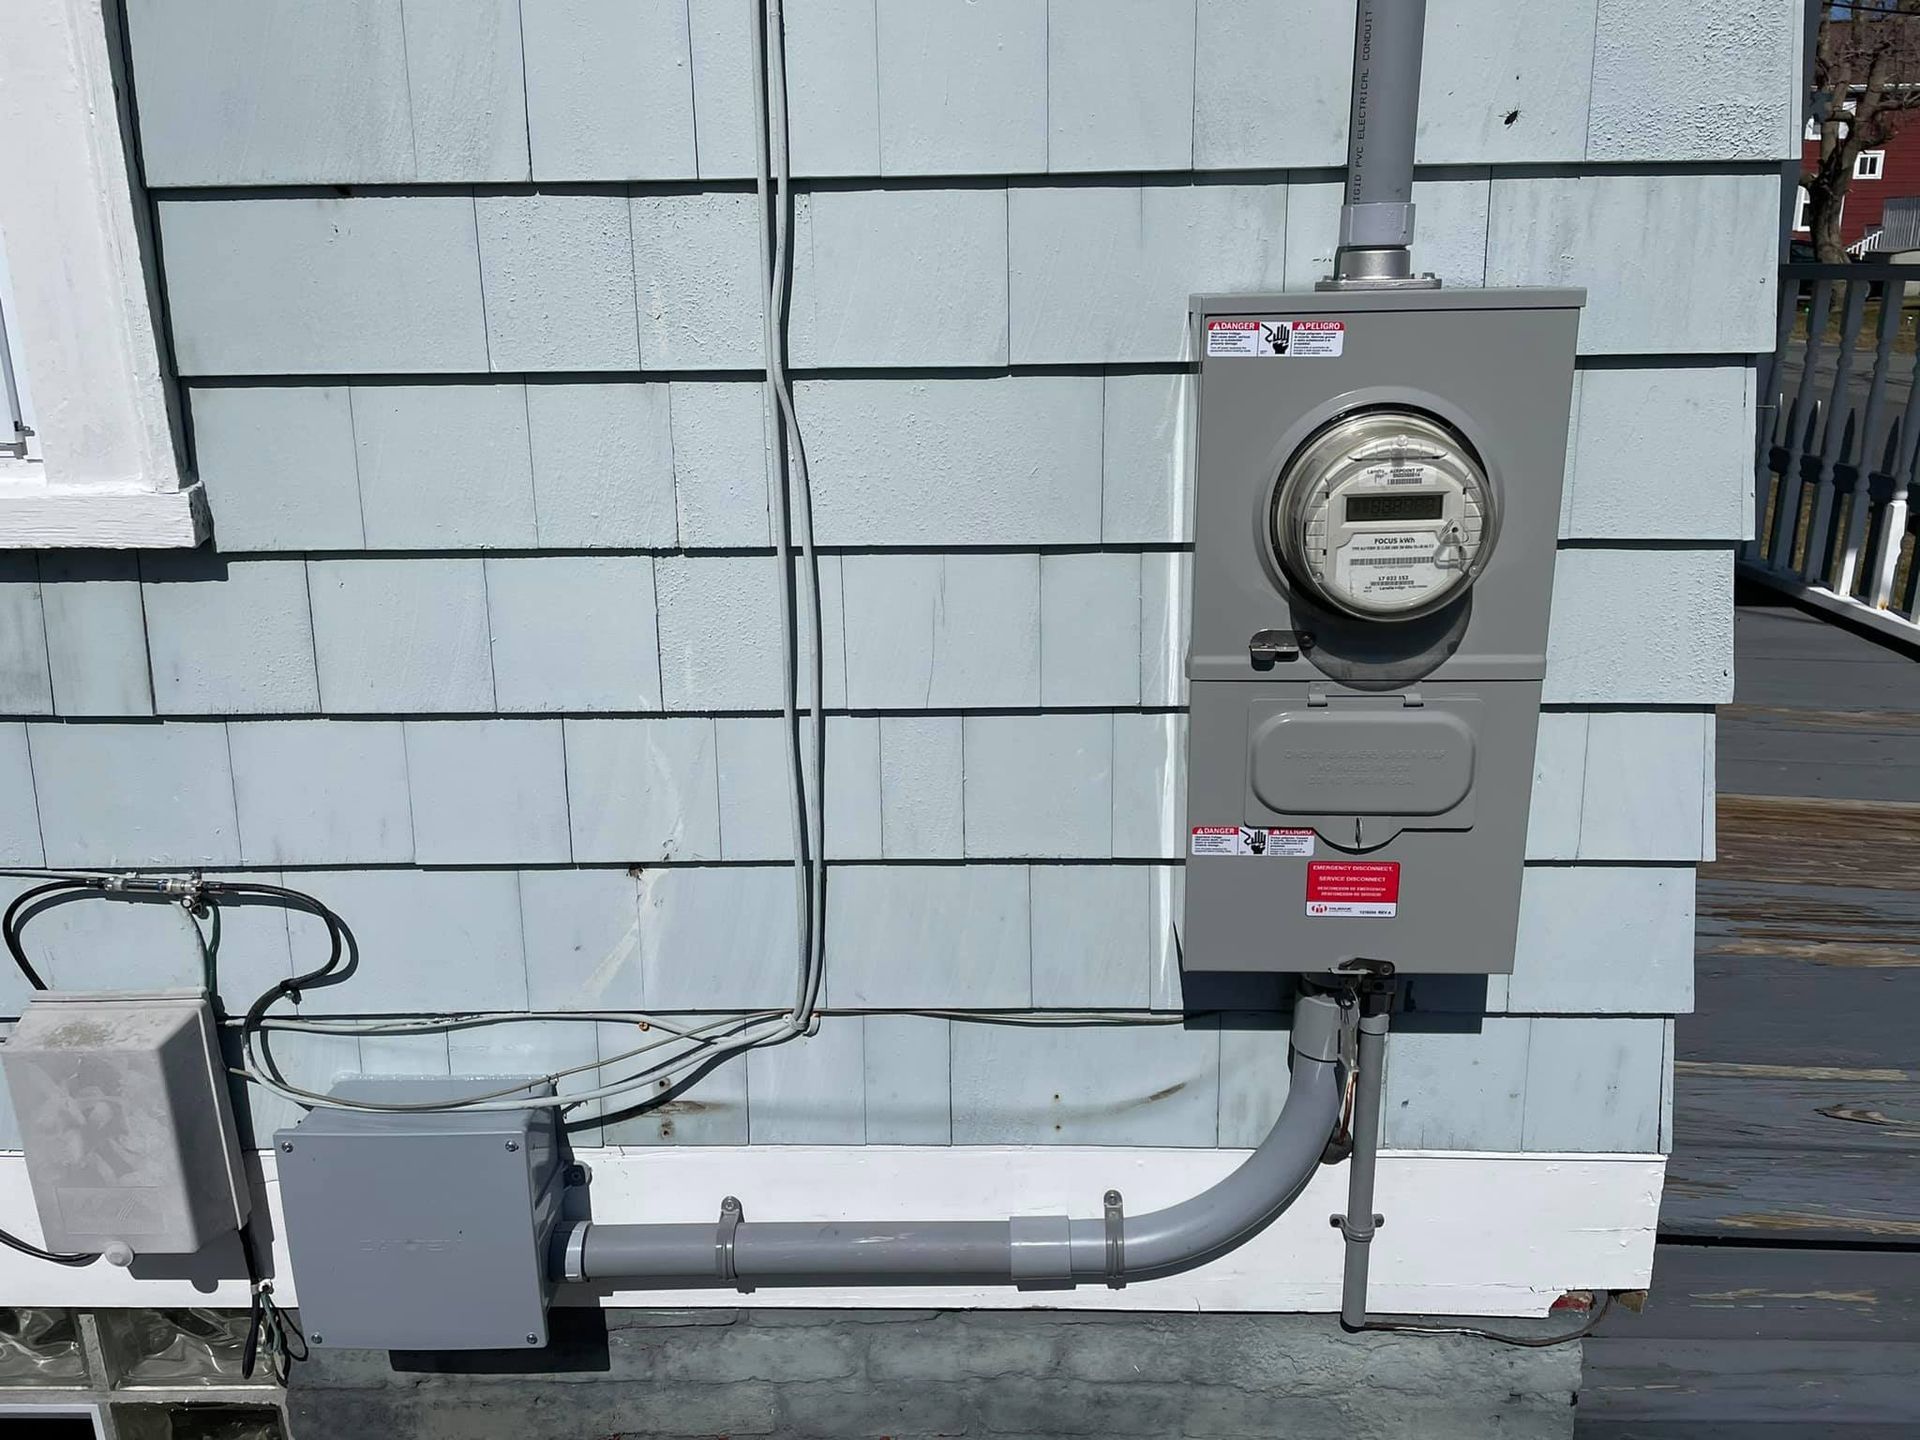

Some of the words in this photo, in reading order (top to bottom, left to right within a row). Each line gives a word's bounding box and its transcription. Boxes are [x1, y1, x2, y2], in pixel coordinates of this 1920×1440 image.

[1362, 11, 1373, 61] CONDUIT
[1356, 68, 1370, 140] ELECTRICAL
[1355, 146, 1364, 168] PVC
